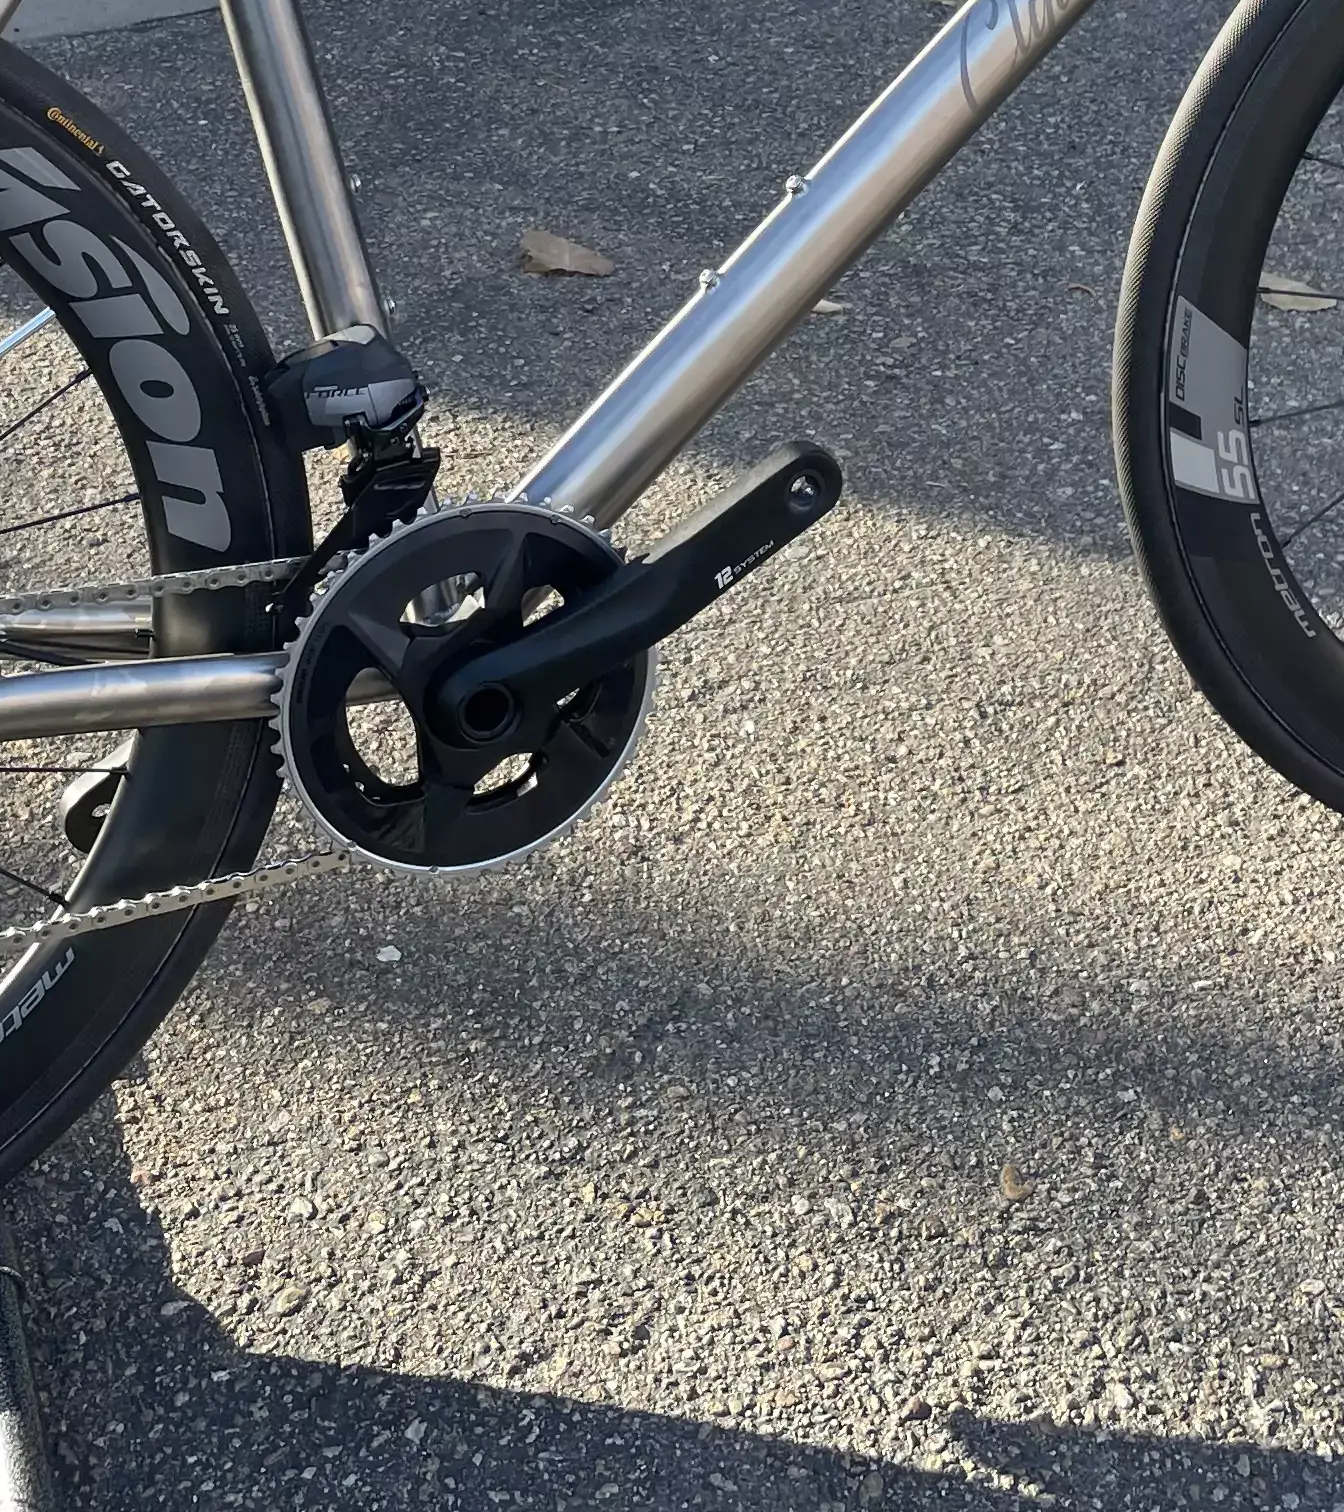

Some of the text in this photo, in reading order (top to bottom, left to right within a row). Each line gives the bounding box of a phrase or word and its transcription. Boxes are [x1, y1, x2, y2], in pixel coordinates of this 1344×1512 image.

[46, 106, 99, 156] Continental
[105, 160, 230, 315] GATORSKIN
[1175, 357, 1189, 402] DISC
[1216, 429, 1255, 499] 55
